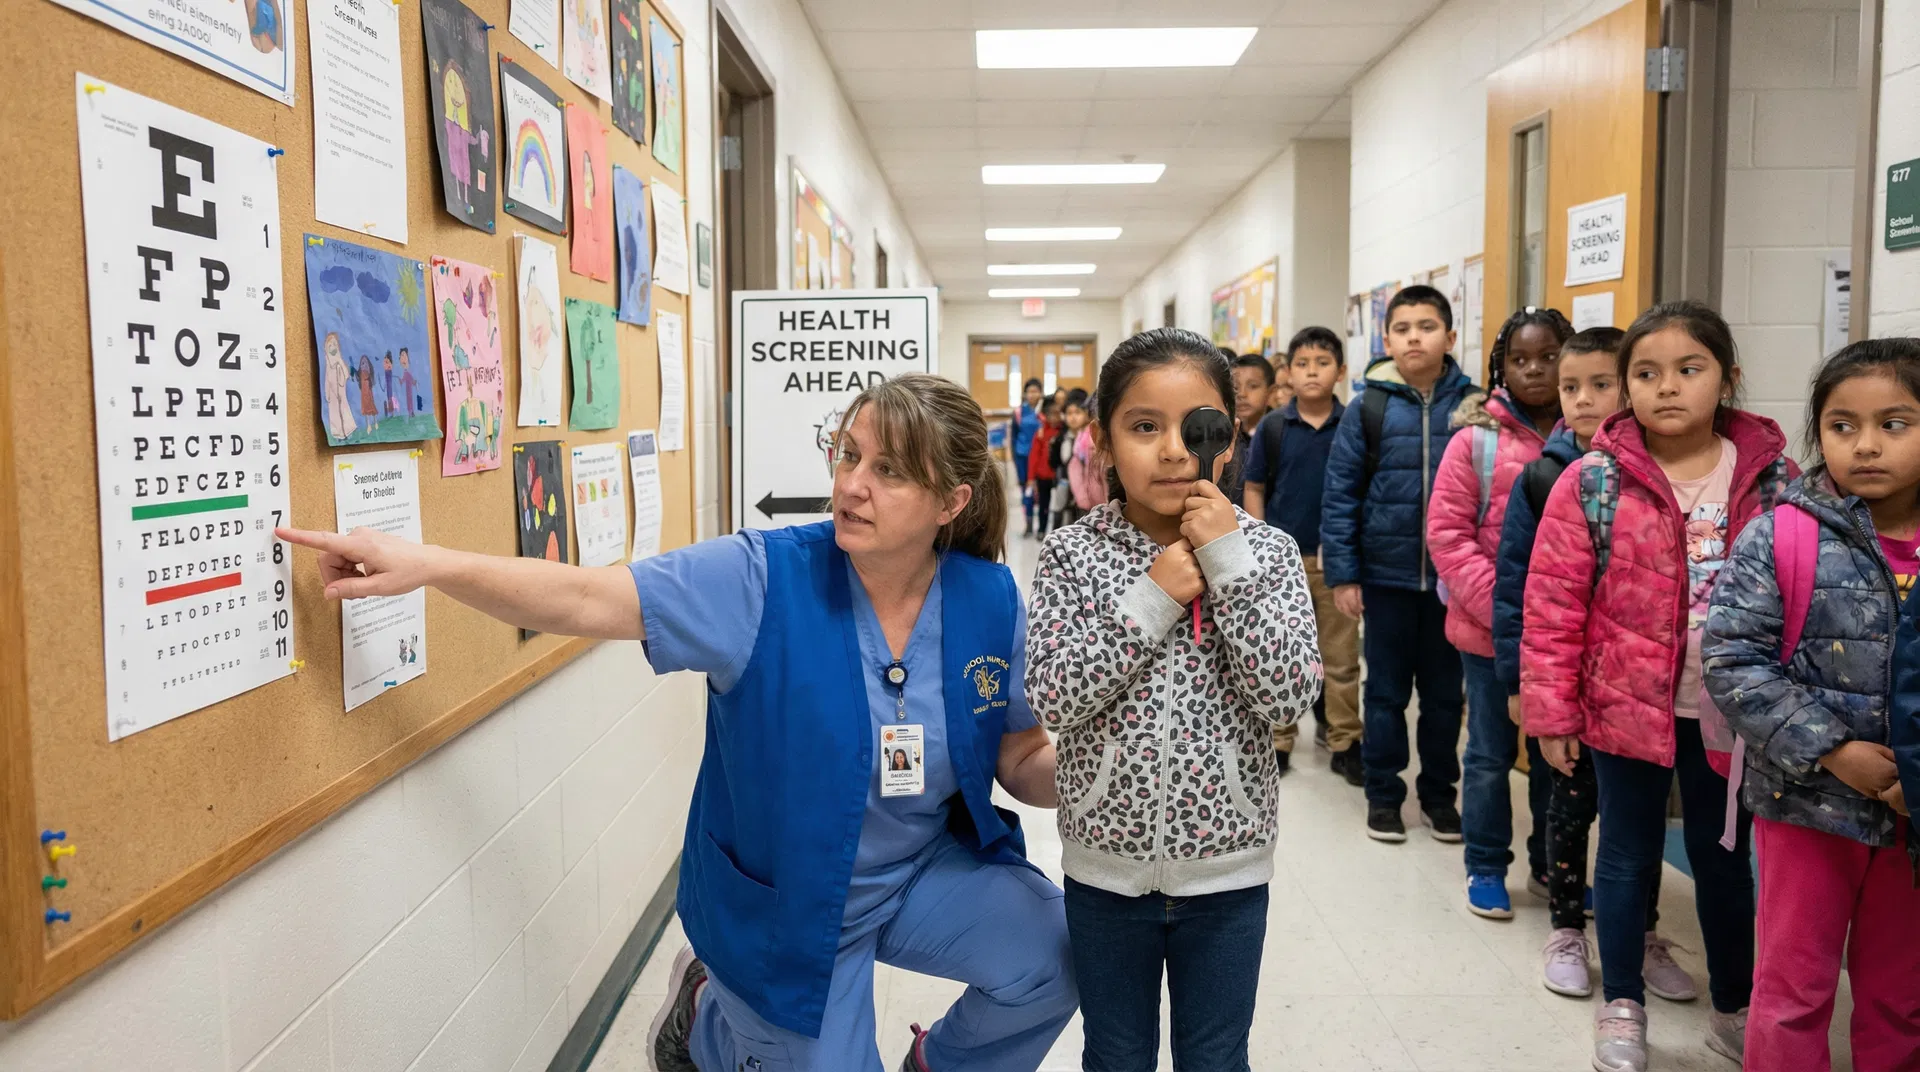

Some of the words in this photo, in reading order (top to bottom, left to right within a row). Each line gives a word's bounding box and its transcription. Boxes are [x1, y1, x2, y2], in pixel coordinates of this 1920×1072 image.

[149, 126, 217, 240] E
[1579, 213, 1612, 232] HEALTH
[264, 224, 269, 248] 1
[1571, 229, 1620, 251] SCREENING
[263, 287, 274, 311] 2
[779, 309, 890, 331] HEALTH
[265, 344, 276, 368] 3
[751, 339, 919, 363] SCREENING
[265, 392, 279, 415] 4
[268, 432, 280, 455] 5
[269, 464, 281, 487] 6
[271, 510, 282, 528] 7
[272, 542, 283, 564] 8
[274, 580, 285, 602] 9
[272, 609, 289, 631] 10
[275, 636, 287, 658] 11
